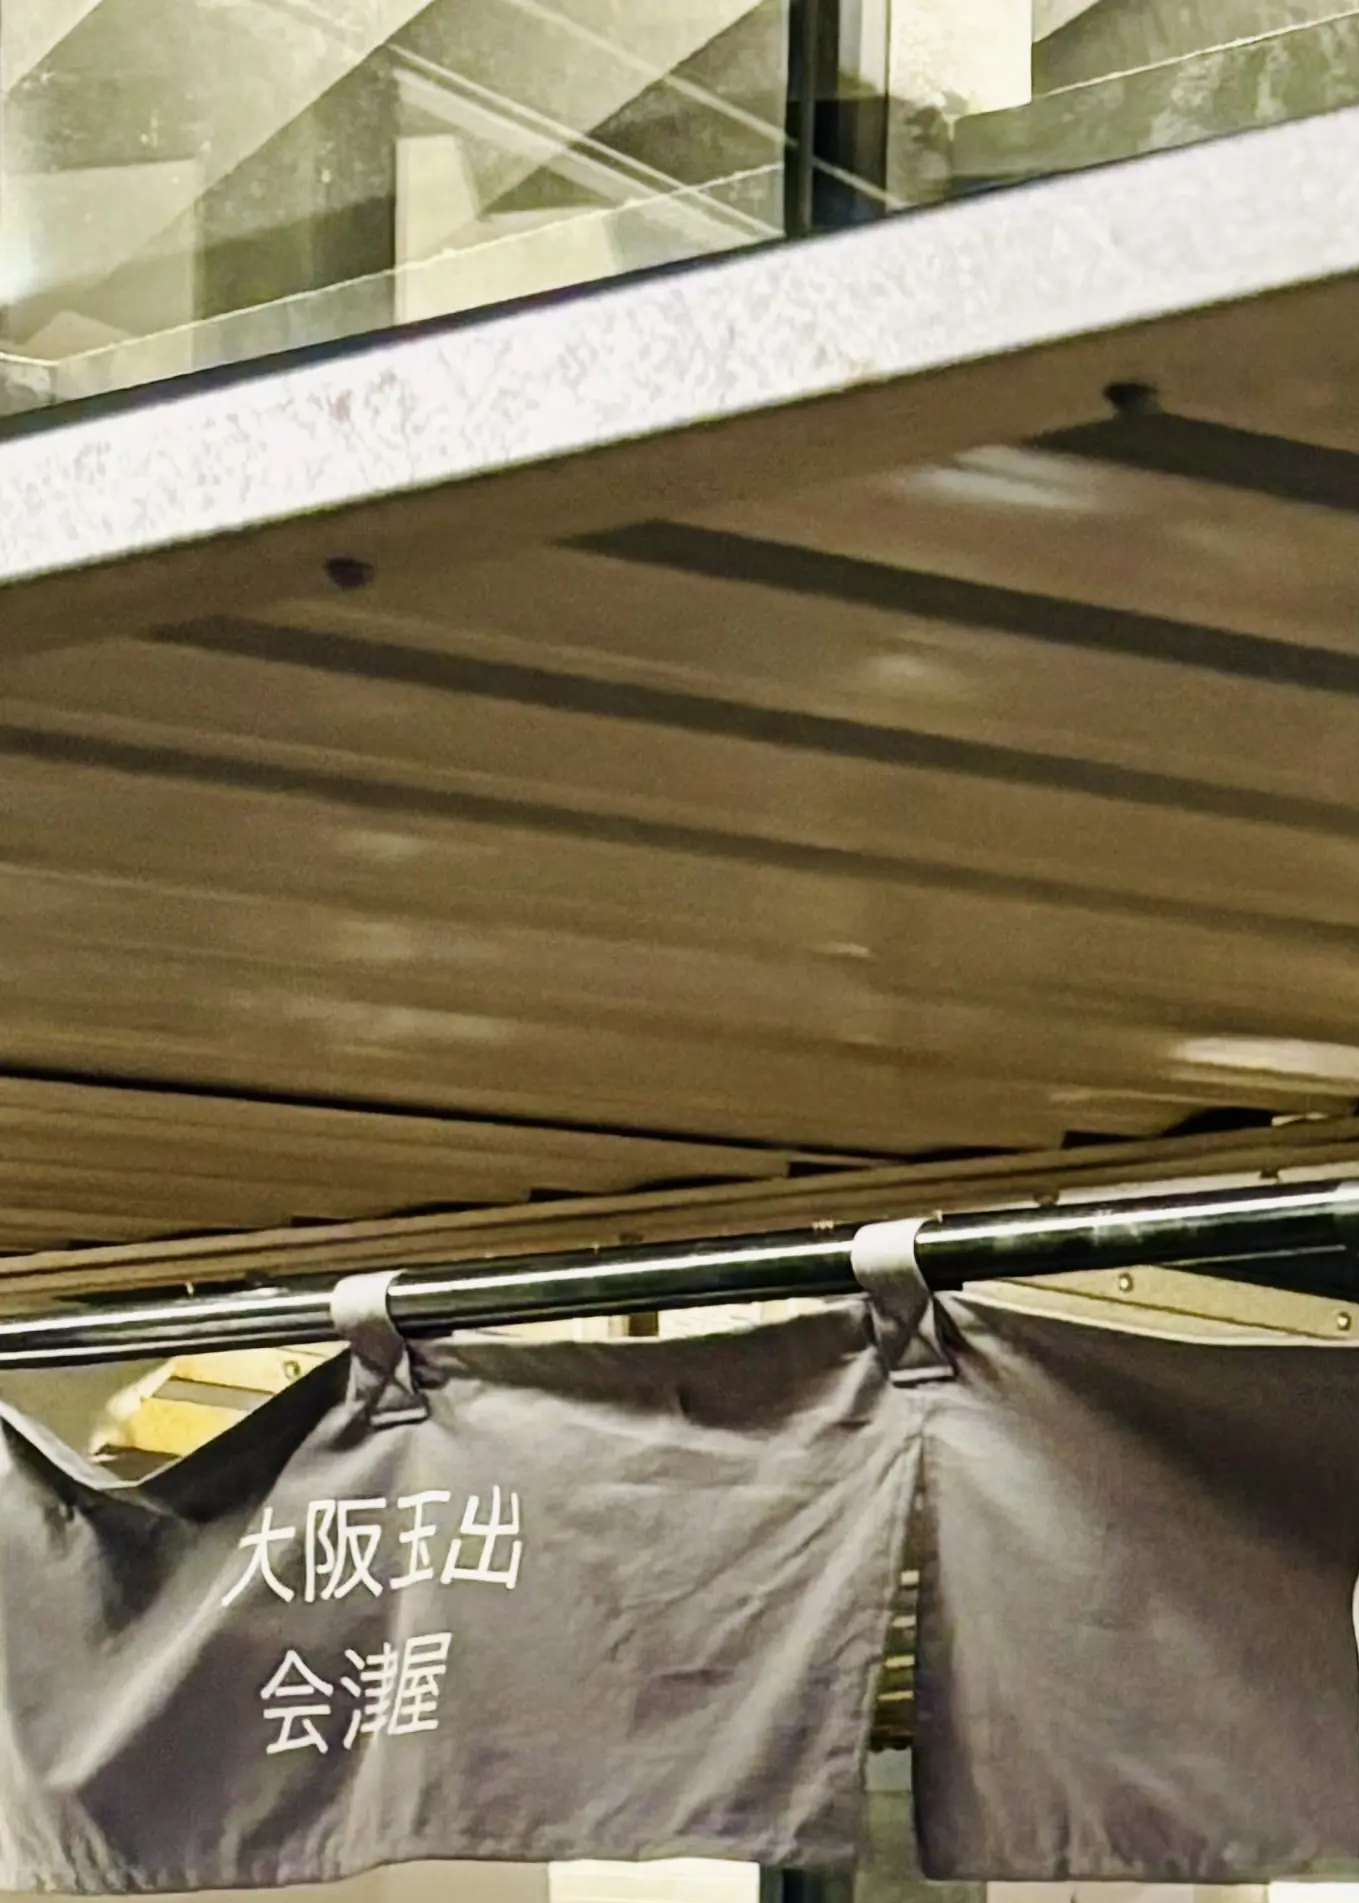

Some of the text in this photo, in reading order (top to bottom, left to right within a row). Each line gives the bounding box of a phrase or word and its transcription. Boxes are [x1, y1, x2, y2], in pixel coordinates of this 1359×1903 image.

[222, 1485, 523, 1606] 大阪玉出
[260, 1632, 452, 1755] 会津屋
